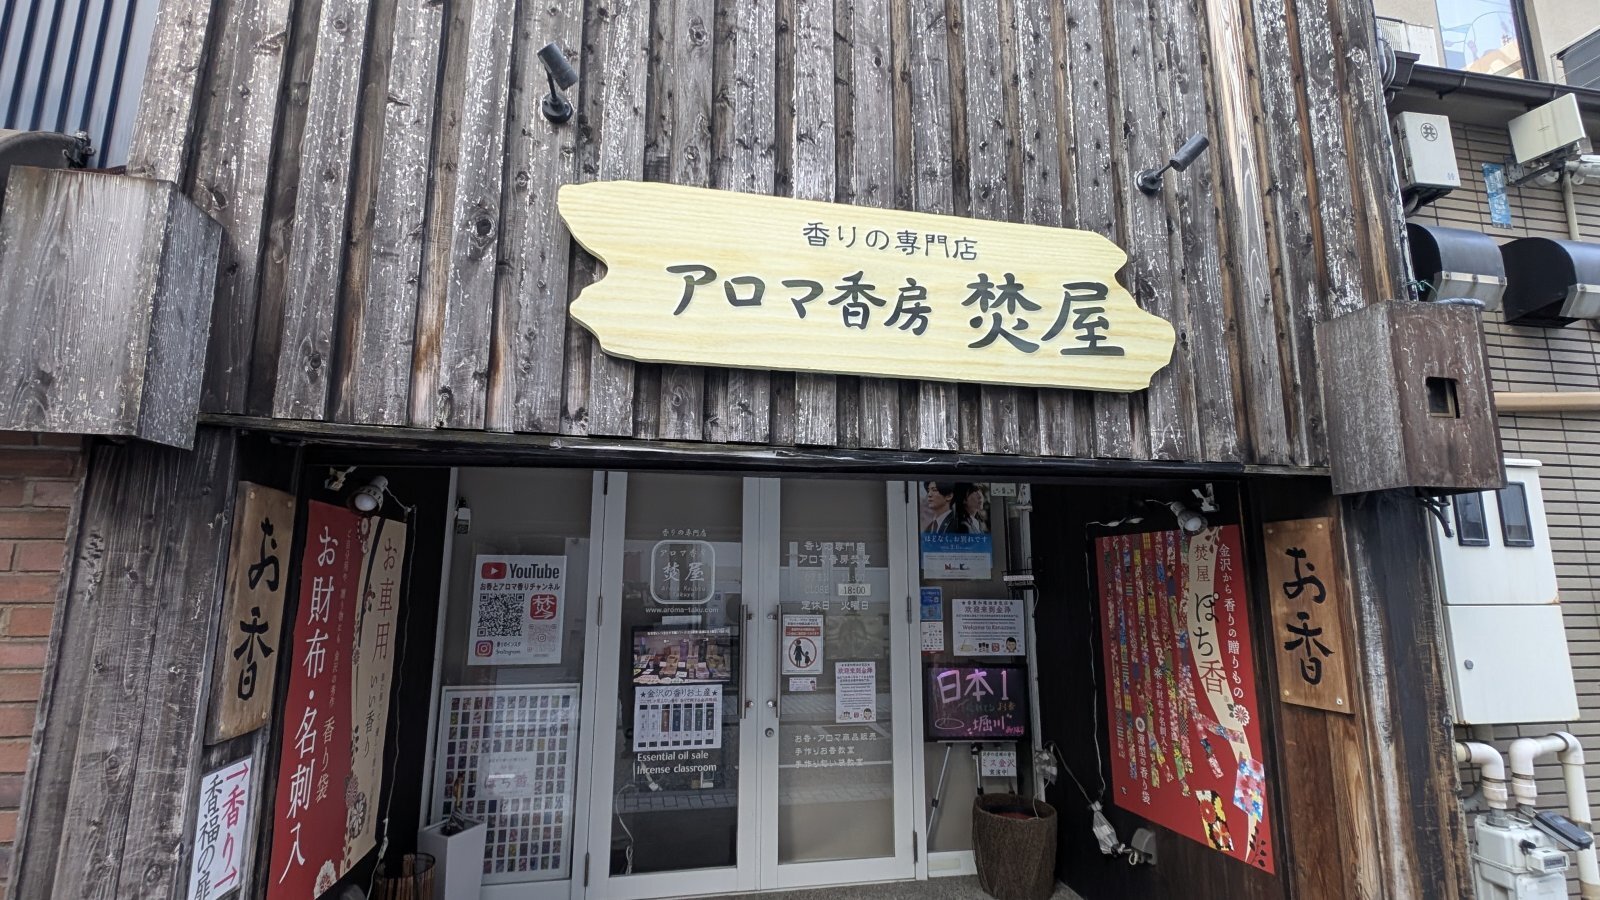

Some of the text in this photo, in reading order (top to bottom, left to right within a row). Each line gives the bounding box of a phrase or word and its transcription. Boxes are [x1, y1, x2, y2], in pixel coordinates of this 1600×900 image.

[1422, 124, 1437, 140] 共
[802, 221, 979, 262] 香りの専門店
[665, 263, 1126, 357] アロマ香房 焚屋
[371, 537, 398, 662] お車用
[509, 563, 560, 579] YouTube
[843, 586, 866, 595] 18:00
[233, 516, 280, 701] お香
[801, 600, 869, 611] 定休日 火曜日
[1193, 544, 1227, 695] 焚屋 ぽち香
[1218, 543, 1245, 699] 金沢から香りの贈りもの
[1282, 546, 1336, 686] お香
[316, 715, 336, 804] 香り袋
[636, 751, 709, 762] Essential oil sale
[636, 763, 717, 775] Incense classroom
[794, 732, 878, 743] お香・アロマ商品販売
[221, 784, 246, 874] 香り
